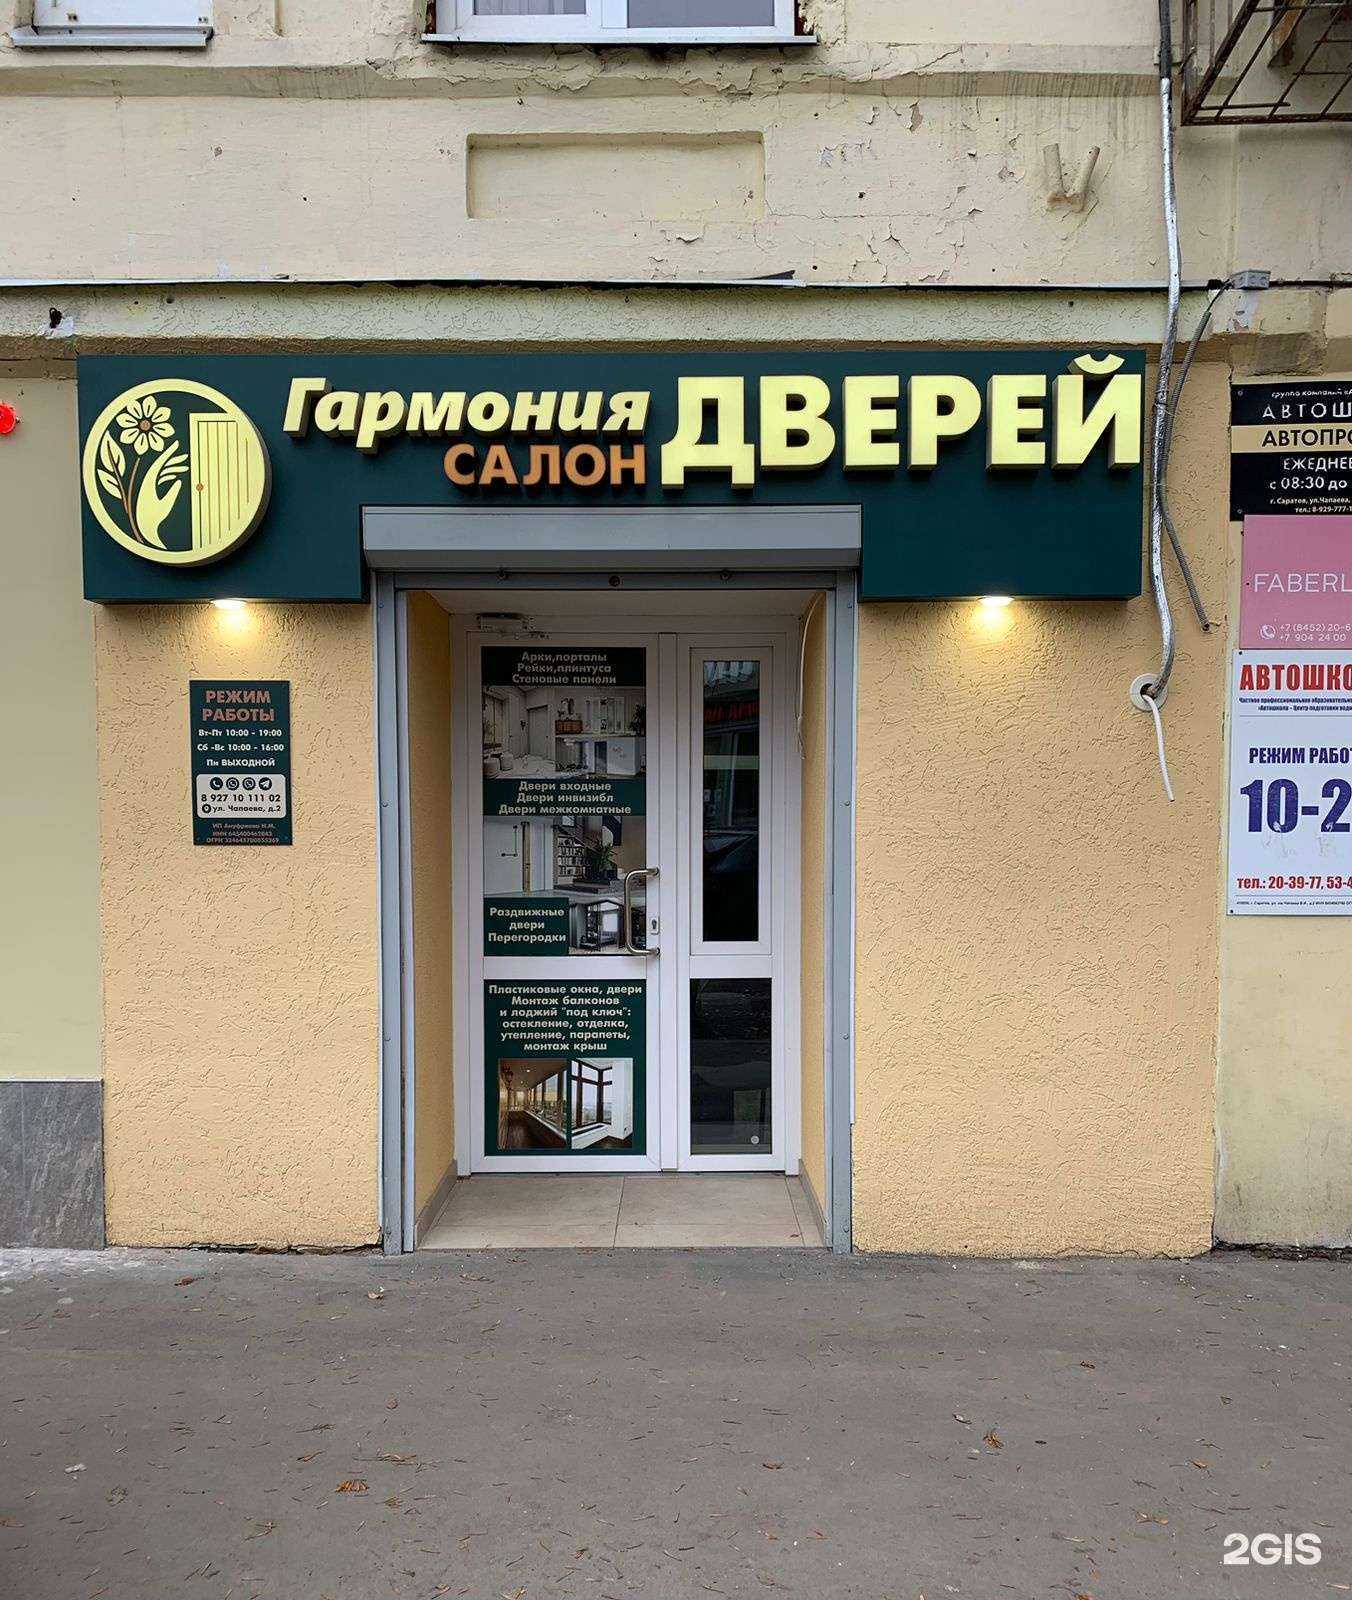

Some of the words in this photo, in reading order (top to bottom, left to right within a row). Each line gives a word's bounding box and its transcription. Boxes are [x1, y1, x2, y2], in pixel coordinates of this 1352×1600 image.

[1262, 402, 1352, 419] АВТОШ
[282, 377, 651, 452] Гармония
[661, 353, 1142, 488] ДВЕРЕЙ
[444, 444, 647, 486] САЛОН
[1269, 481, 1277, 490] с
[1281, 477, 1325, 490] 08:30
[1327, 480, 1348, 491] до
[1254, 573, 1352, 593] FABERL
[1280, 624, 1291, 632] +7
[1280, 633, 1290, 641] +7
[1295, 633, 1313, 641] 904
[1319, 633, 1330, 641] 24
[1333, 633, 1346, 641] 00
[512, 674, 569, 684] Стеновые
[573, 676, 617, 684] панели
[1239, 664, 1352, 691] АВТОШКО
[205, 690, 271, 704] РЕЖИМ
[202, 708, 275, 722] РАБОТЫ
[198, 729, 223, 737] Вт-Пт
[226, 729, 249, 737] 10:00
[259, 729, 282, 737] 19:00
[197, 743, 209, 751] Сб
[228, 743, 251, 751] 10:00
[261, 743, 284, 751] 16:00
[1249, 747, 1305, 764] РЕЖИМ
[221, 757, 276, 767] ВЫХОДНОЙ
[519, 781, 556, 792] Двери
[560, 783, 611, 792] входные
[201, 794, 208, 802] 8
[211, 794, 229, 802] 927
[233, 794, 244, 802] 10
[248, 794, 265, 802] 111
[268, 794, 281, 802] 02
[517, 793, 554, 804] Двери
[558, 793, 614, 802] инвизибл
[228, 805, 266, 813] Чапаева,
[268, 805, 281, 813] д.2
[499, 804, 536, 815] Двери
[539, 805, 632, 814] межкомнатные
[1240, 778, 1352, 833] 10-2
[1237, 876, 1266, 889] тел.:
[1268, 876, 1324, 891] 20-39-77,
[489, 907, 565, 917] Раздвижные
[509, 921, 545, 931] двери
[488, 932, 567, 943] Перегородки
[488, 985, 567, 994] Пластиковые
[570, 985, 603, 995] окна,
[606, 985, 642, 996] двери
[511, 996, 559, 1005] Монтаж
[562, 995, 620, 1005] балконов
[511, 1007, 558, 1018] лоджий
[561, 1007, 589, 1018] "под
[502, 1020, 573, 1030] остекление,
[577, 1020, 629, 1030] отделка,
[500, 1031, 566, 1041] утепление,
[569, 1031, 631, 1041] парапеты,
[523, 1042, 570, 1051] монтаж
[573, 1042, 607, 1052] крыш
